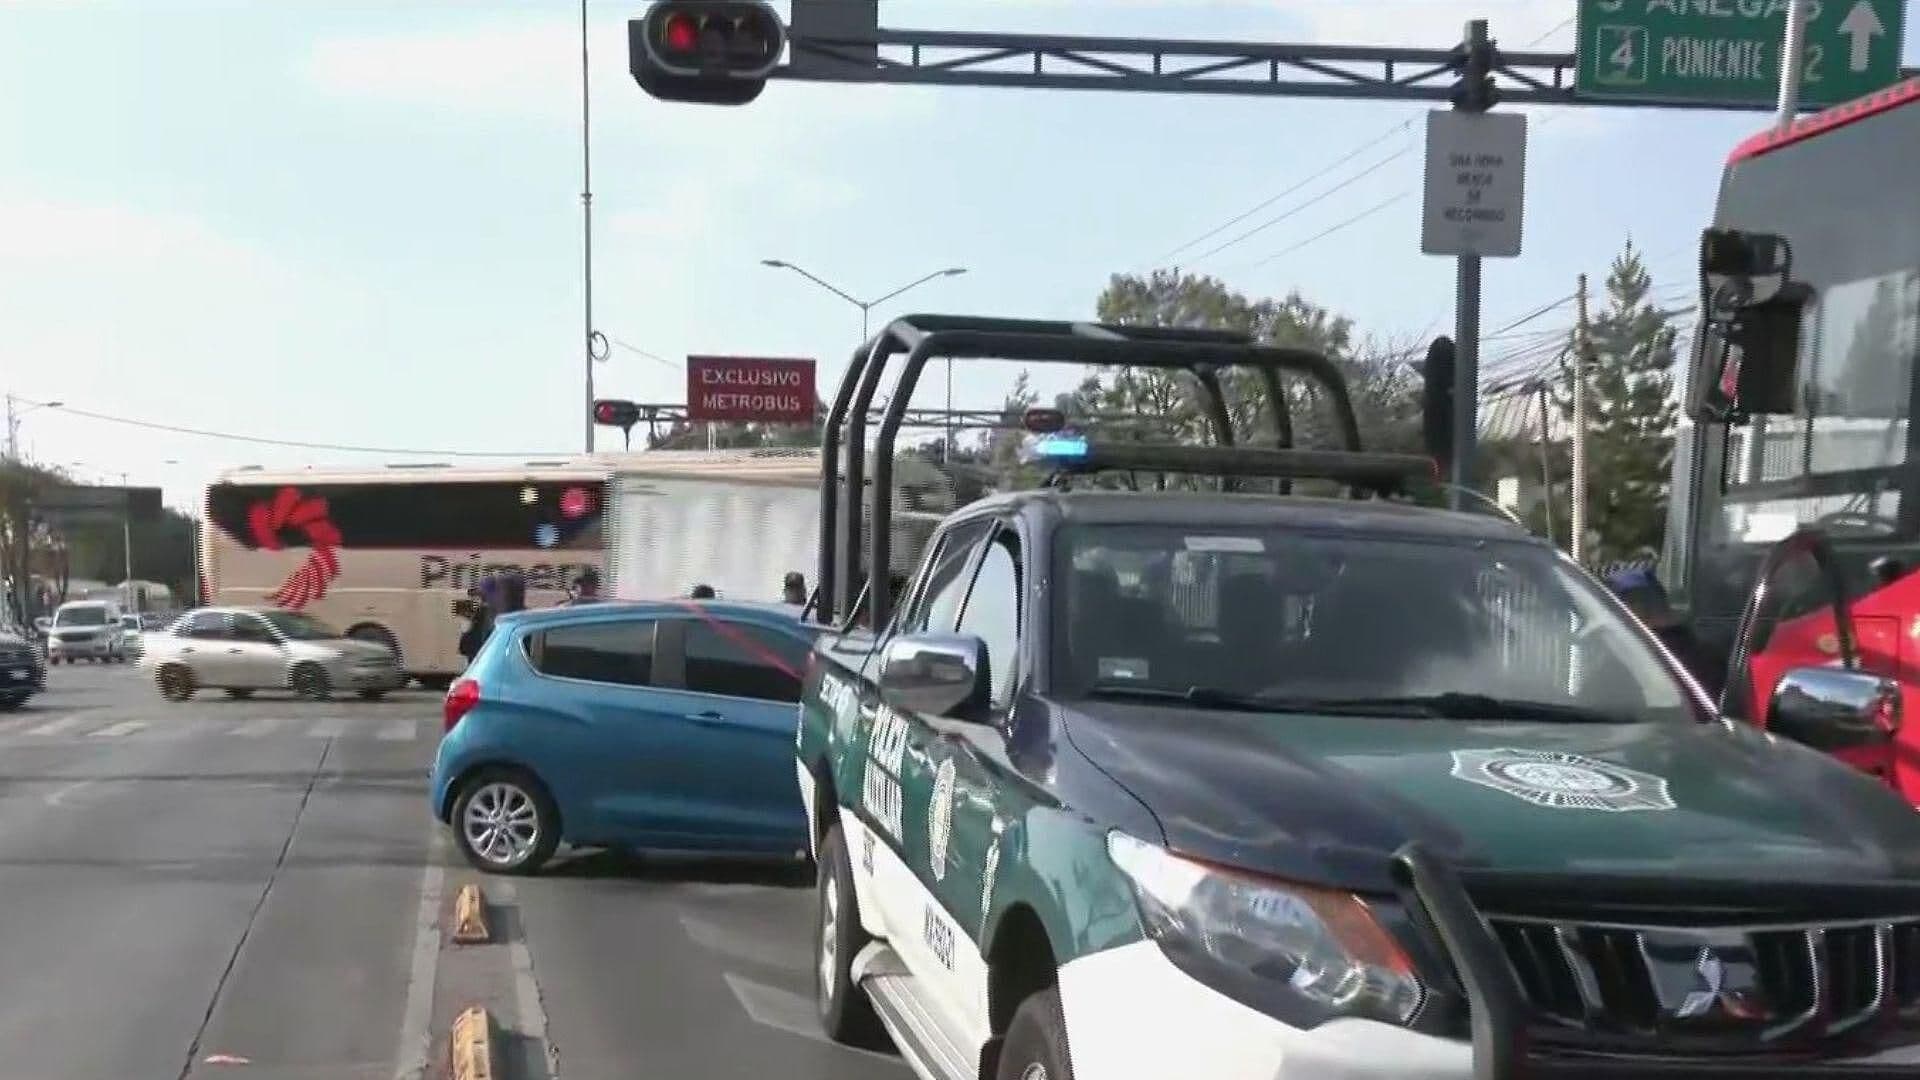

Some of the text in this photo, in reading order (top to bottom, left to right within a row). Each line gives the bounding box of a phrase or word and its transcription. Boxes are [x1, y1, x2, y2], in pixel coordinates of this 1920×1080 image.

[1610, 36, 1634, 73] 4
[1661, 36, 1765, 80] PONIENTE
[702, 368, 800, 386] EXCLUSIVO
[702, 393, 800, 411] METROBUS
[421, 553, 598, 590] Primer
